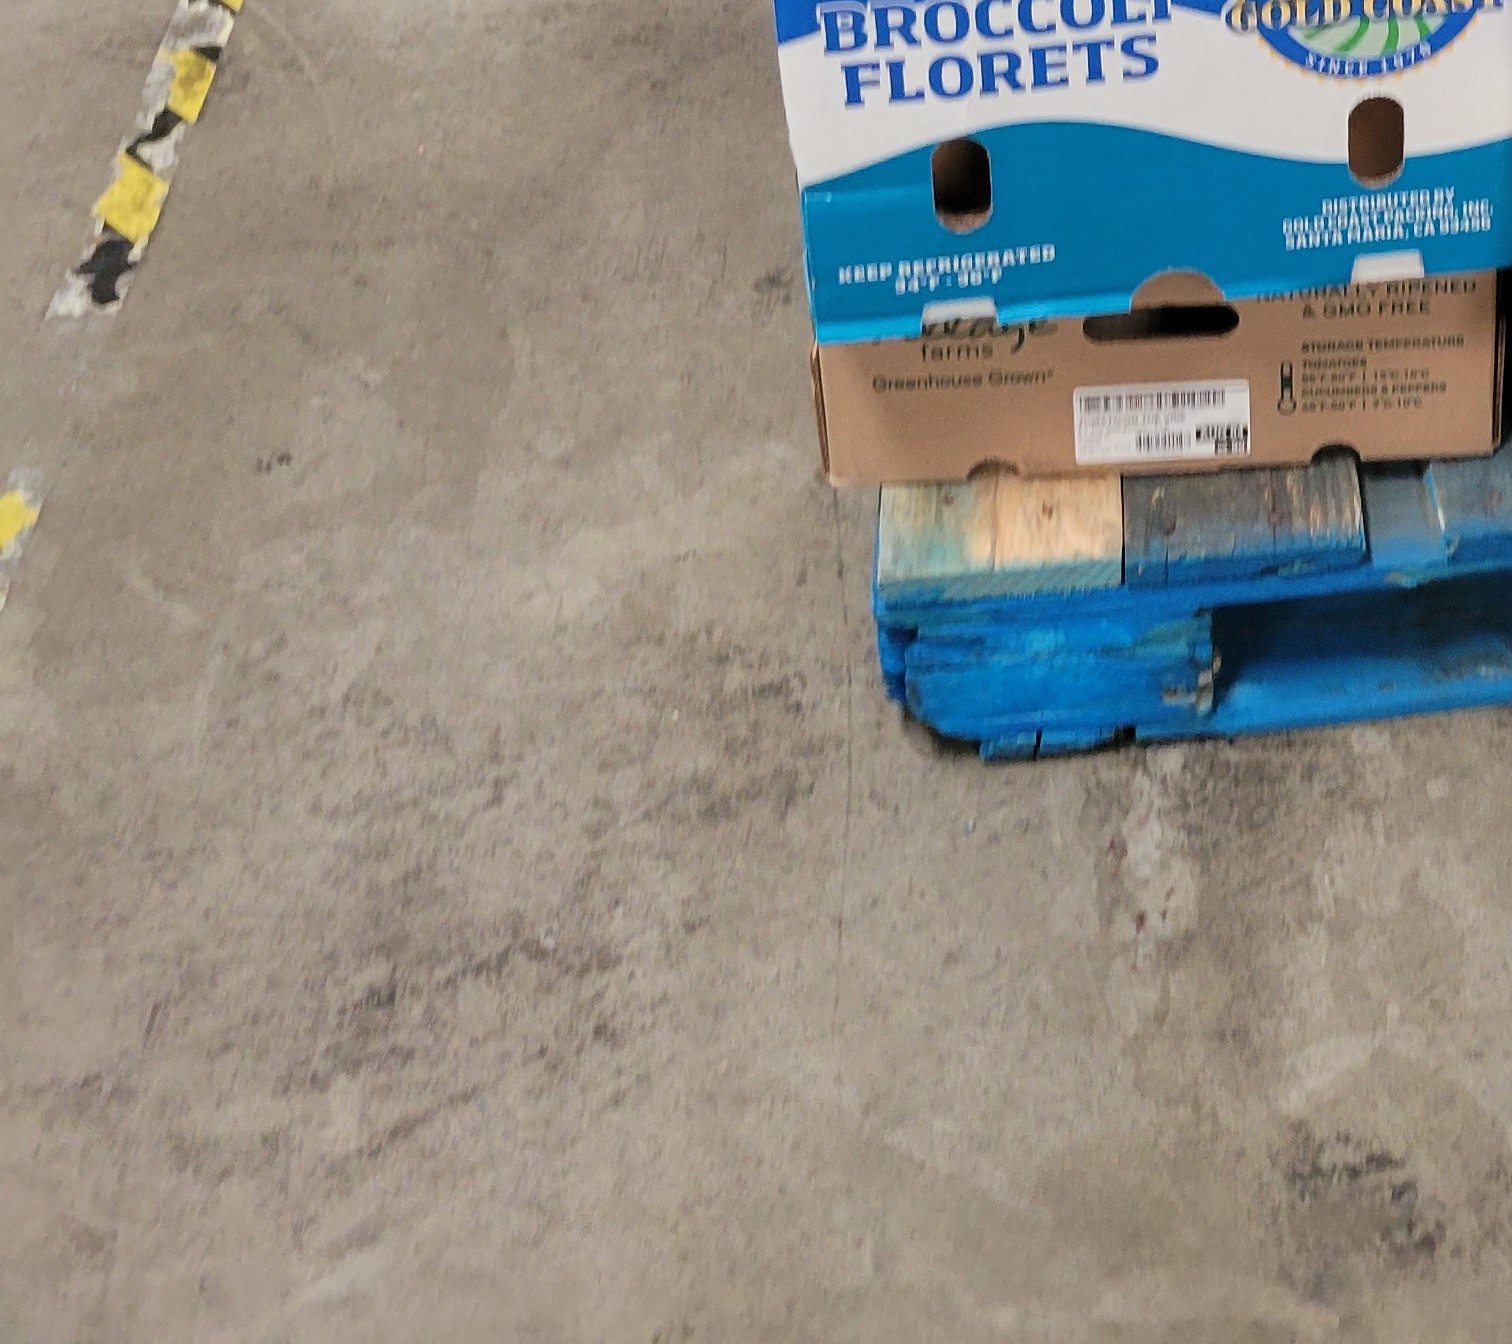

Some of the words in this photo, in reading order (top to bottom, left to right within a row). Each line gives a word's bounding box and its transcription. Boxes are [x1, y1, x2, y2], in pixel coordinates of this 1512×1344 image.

[840, 32, 1160, 109] FLORETS
[1304, 50, 1369, 77] SINCE
[1284, 228, 1344, 251] SANTA
[1412, 217, 1436, 238] CA
[838, 261, 892, 286] KEEP
[898, 242, 1056, 280] REFRIGERATED
[1386, 278, 1477, 300] RIPENED
[1322, 301, 1372, 318] GMO
[1378, 299, 1431, 315] FREE
[921, 342, 994, 363] farms
[872, 372, 983, 395] Greenhouse
